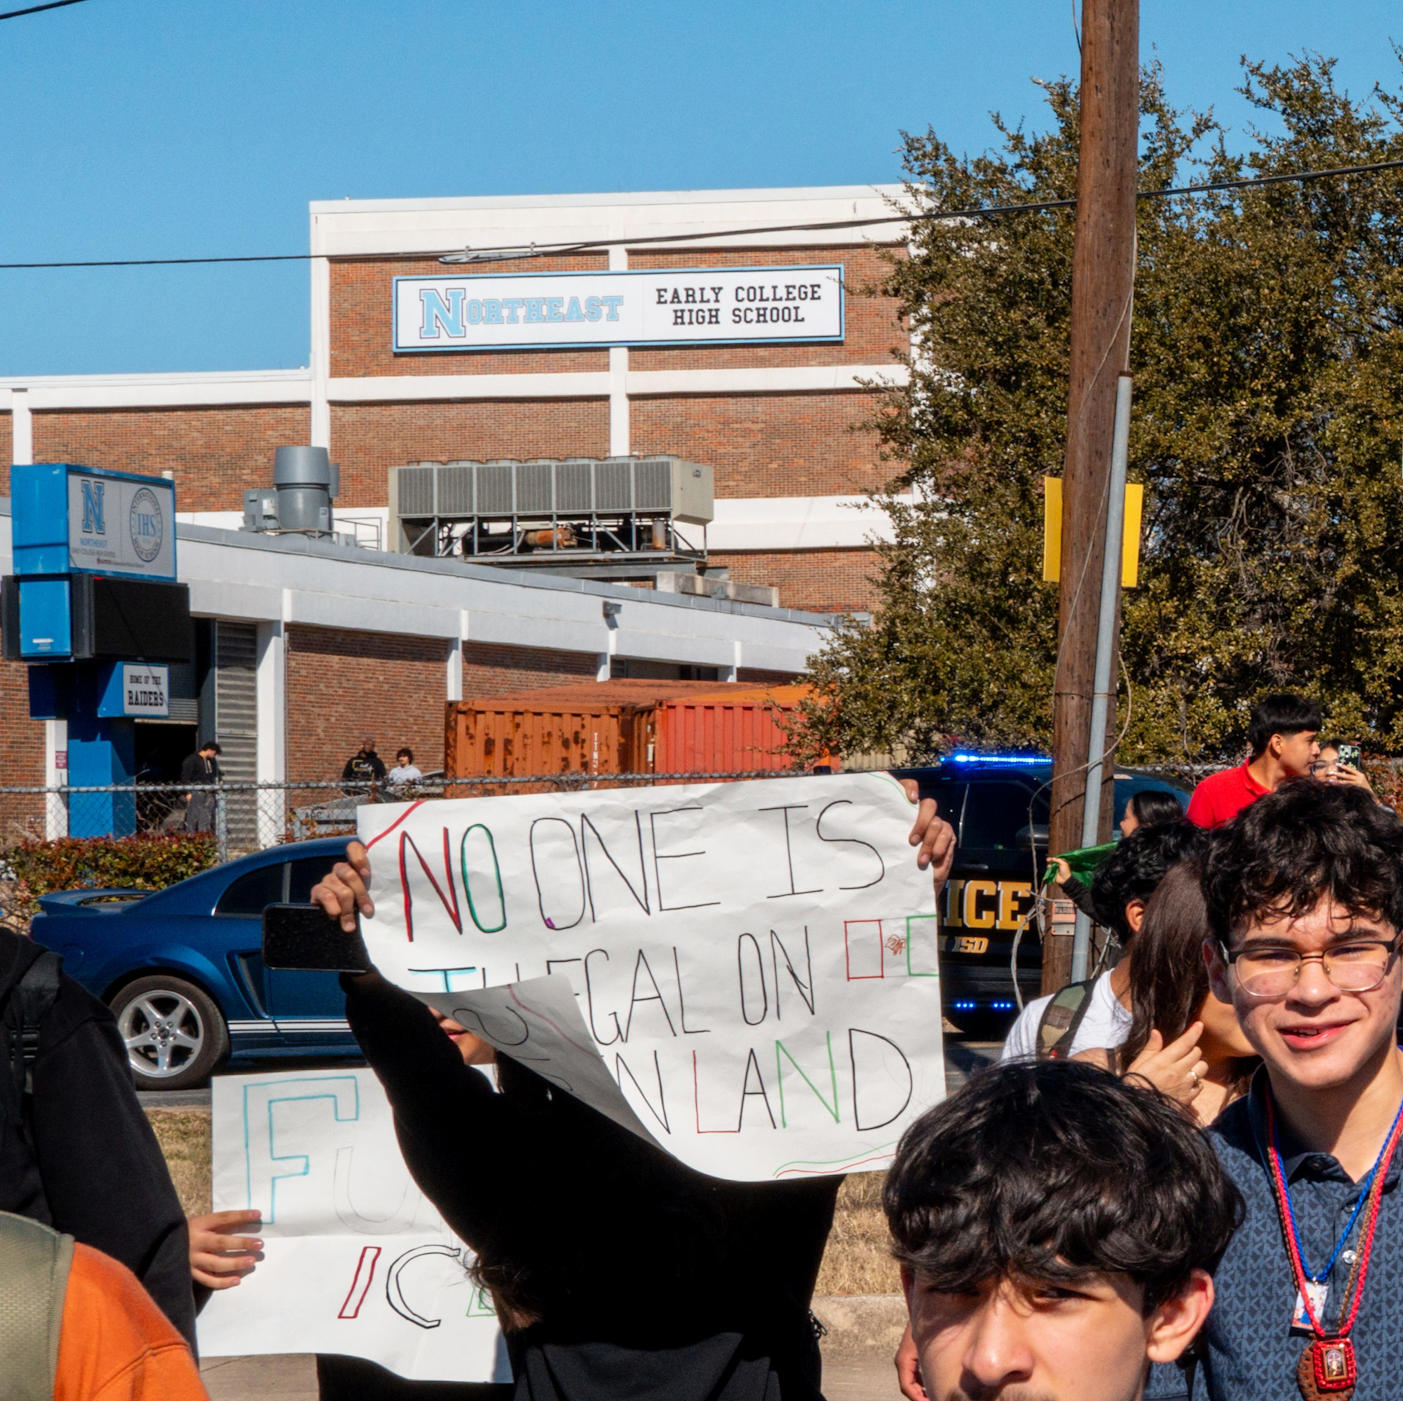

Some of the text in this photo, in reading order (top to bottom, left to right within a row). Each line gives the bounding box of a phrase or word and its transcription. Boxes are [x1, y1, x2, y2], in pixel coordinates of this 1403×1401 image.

[419, 287, 624, 339] NORTHEAST
[656, 283, 822, 305] EARLY COLLEGE
[671, 304, 806, 326] HIGH SCHOOL
[128, 690, 164, 706] RAIDERS
[400, 800, 885, 942] NO ONE IS
[738, 925, 815, 1026] ON
[693, 1027, 913, 1135] LAND
